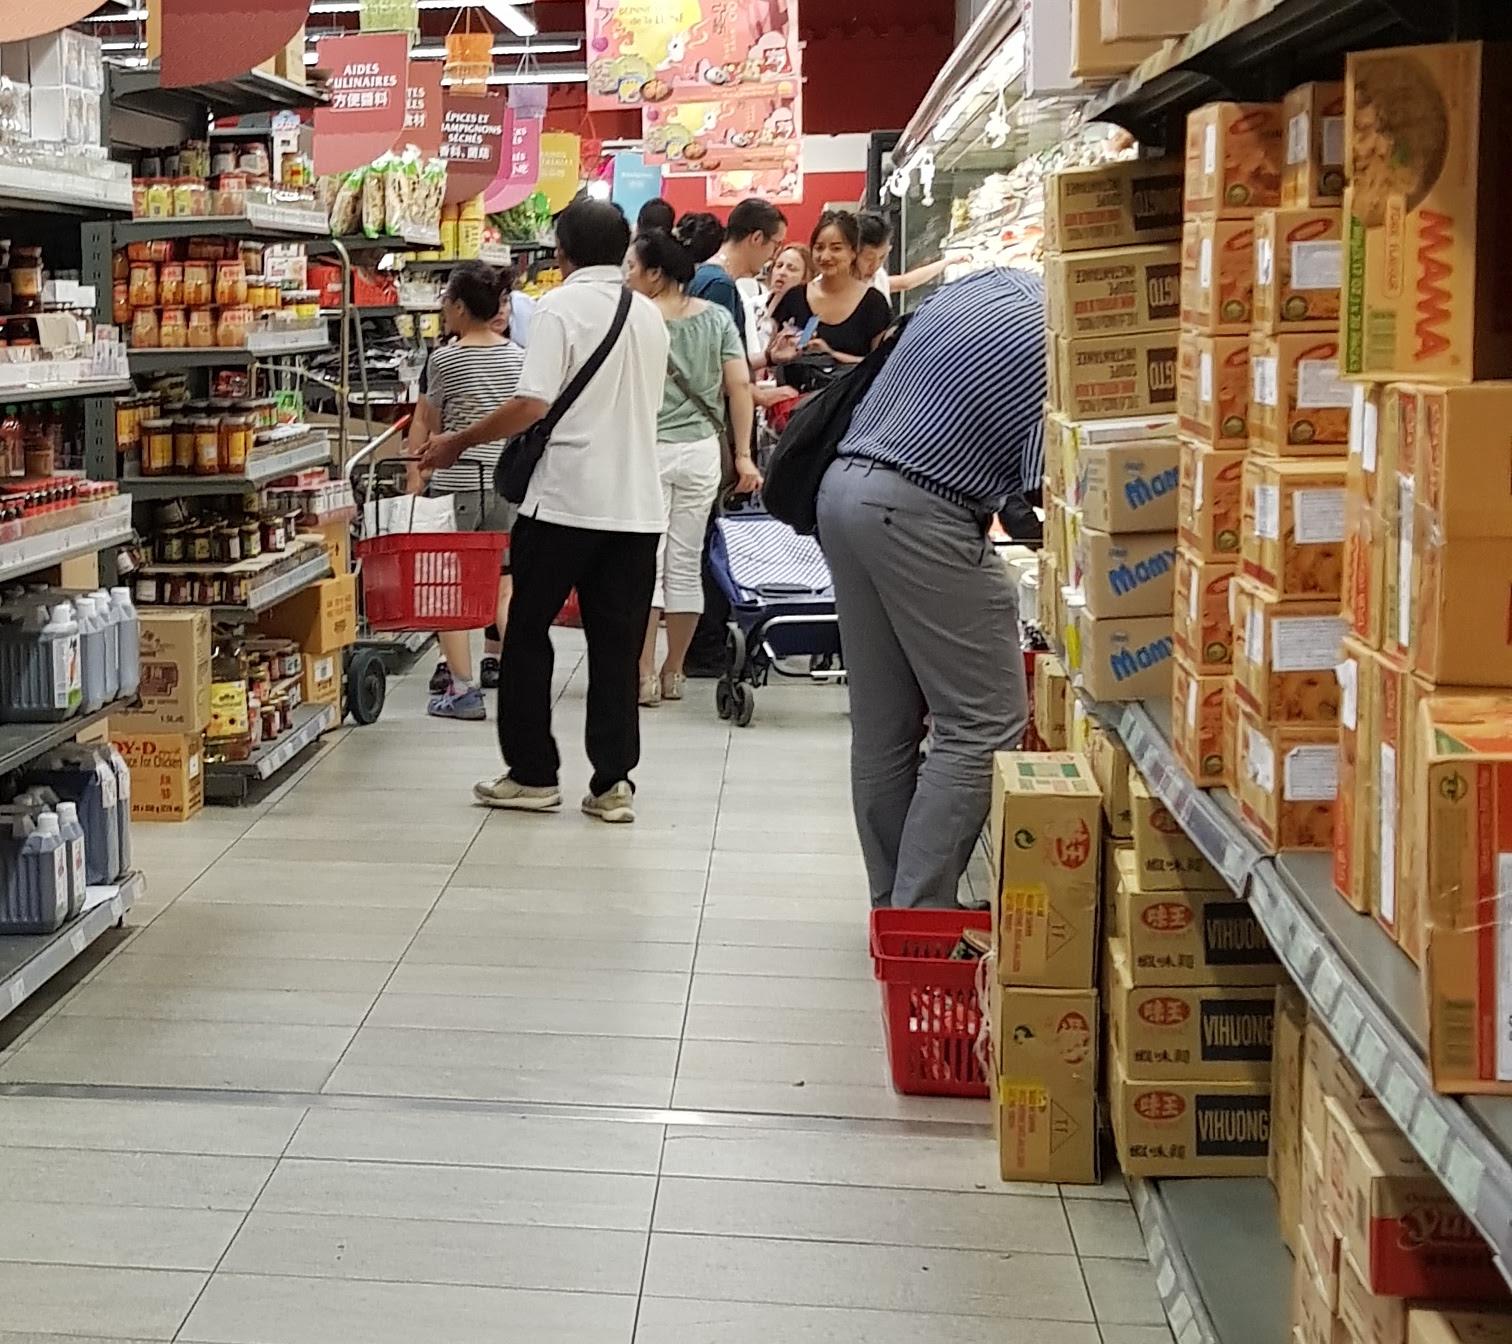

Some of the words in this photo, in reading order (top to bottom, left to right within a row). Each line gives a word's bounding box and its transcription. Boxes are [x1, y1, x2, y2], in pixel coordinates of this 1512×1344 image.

[343, 62, 380, 76] AIDES
[445, 110, 477, 123] ÉPICES
[477, 113, 490, 124] ET
[1412, 210, 1455, 360] MAMA
[1204, 1014, 1273, 1047] VIHUONG
[1199, 1109, 1269, 1143] VIHUONG
